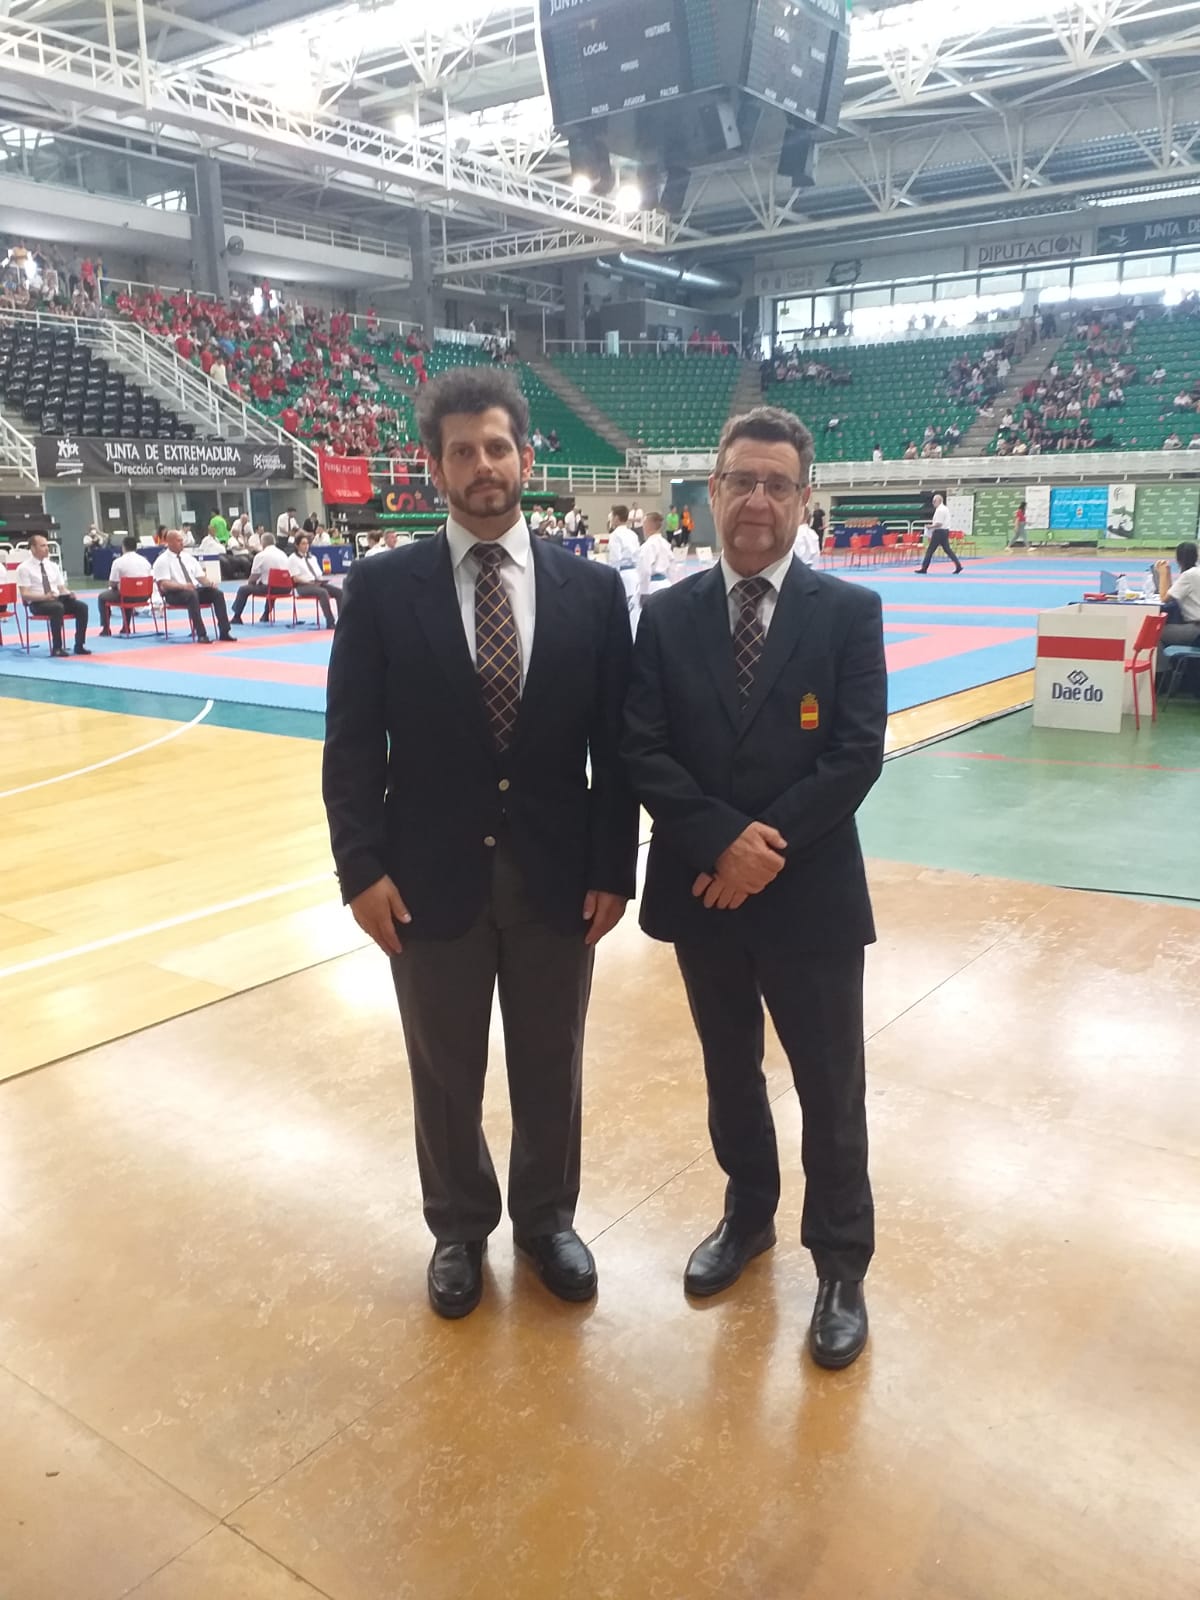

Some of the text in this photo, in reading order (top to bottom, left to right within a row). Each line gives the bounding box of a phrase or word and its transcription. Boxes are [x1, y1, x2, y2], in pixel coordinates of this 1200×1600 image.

[583, 41, 608, 56] LOCAL
[1144, 221, 1181, 241] JUNTA
[104, 442, 140, 462] JUNTA
[145, 444, 159, 461] DE
[164, 444, 241, 462] EXTREMADURA
[113, 461, 236, 478] Dirección General de Deportes
